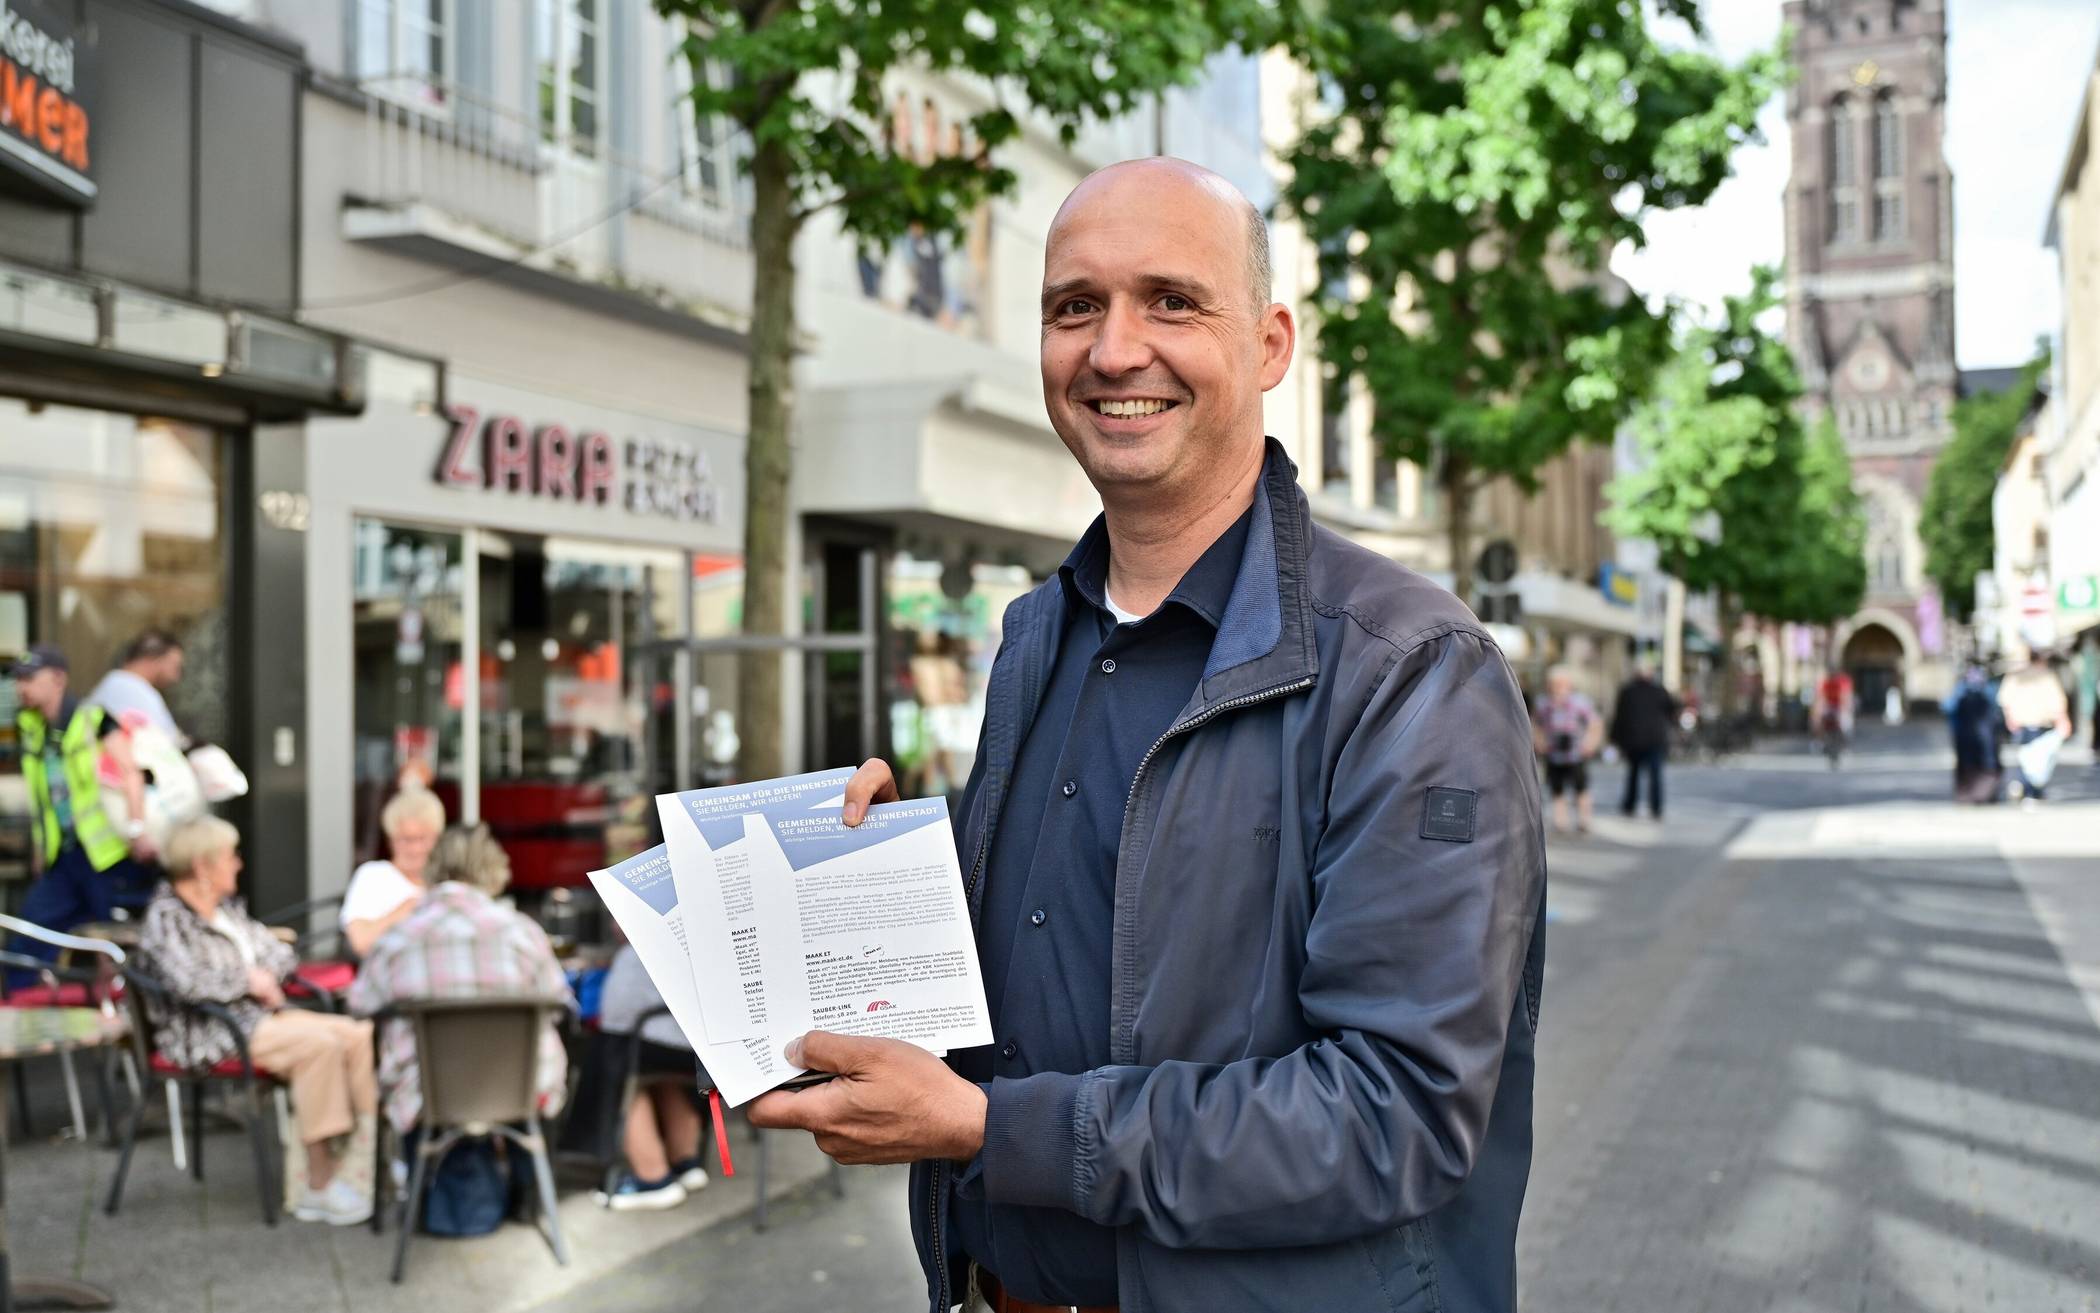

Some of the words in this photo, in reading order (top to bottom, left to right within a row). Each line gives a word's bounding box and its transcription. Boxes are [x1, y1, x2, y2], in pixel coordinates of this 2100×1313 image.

[437, 404, 616, 506] ZARA
[692, 794, 750, 808] GEMEINSAM
[752, 788, 771, 799] FÜR
[774, 786, 790, 796] DIE
[792, 777, 849, 792] INNENSTADT
[696, 808, 711, 816] SIE
[712, 803, 749, 813] MELDEN,
[769, 792, 801, 803] HELFEN!
[778, 817, 836, 828] GEMEINSAM
[879, 807, 938, 820] INNENSTADT
[797, 825, 834, 834] MELDEN,
[632, 876, 645, 885] SIE
[806, 955, 852, 966] www.maak-et.de
[743, 980, 763, 988] SAUBE
[812, 1004, 851, 1014] SAUBER-LINE
